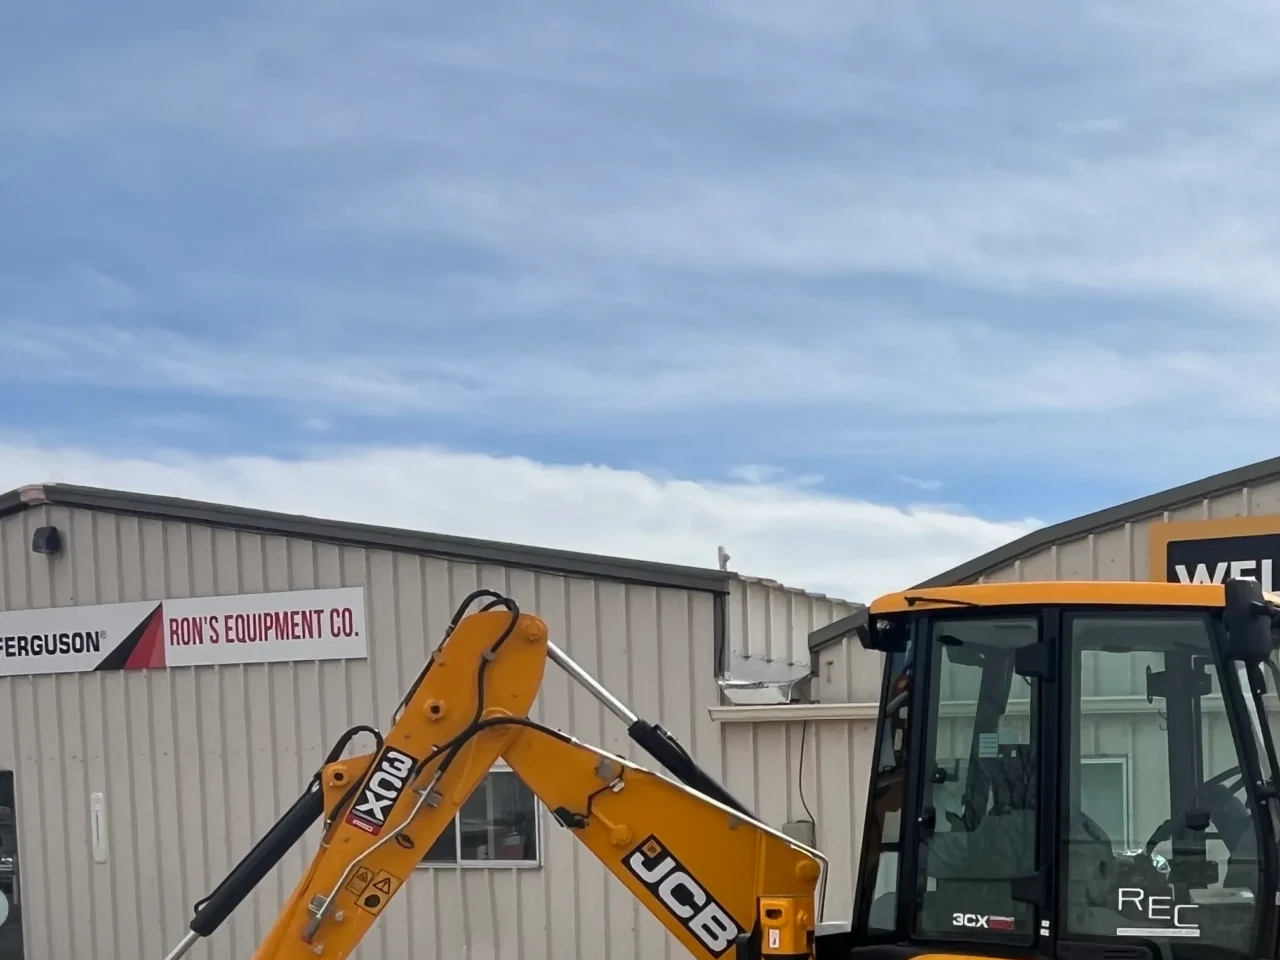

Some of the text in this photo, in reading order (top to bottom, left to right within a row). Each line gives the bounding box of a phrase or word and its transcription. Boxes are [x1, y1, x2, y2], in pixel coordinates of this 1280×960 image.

[169, 607, 359, 646] RON'S EQUIPMENT CO.
[355, 751, 413, 821] 3CX
[629, 851, 738, 952] JCB
[952, 912, 989, 929] 3CX
[1118, 887, 1199, 927] REC
